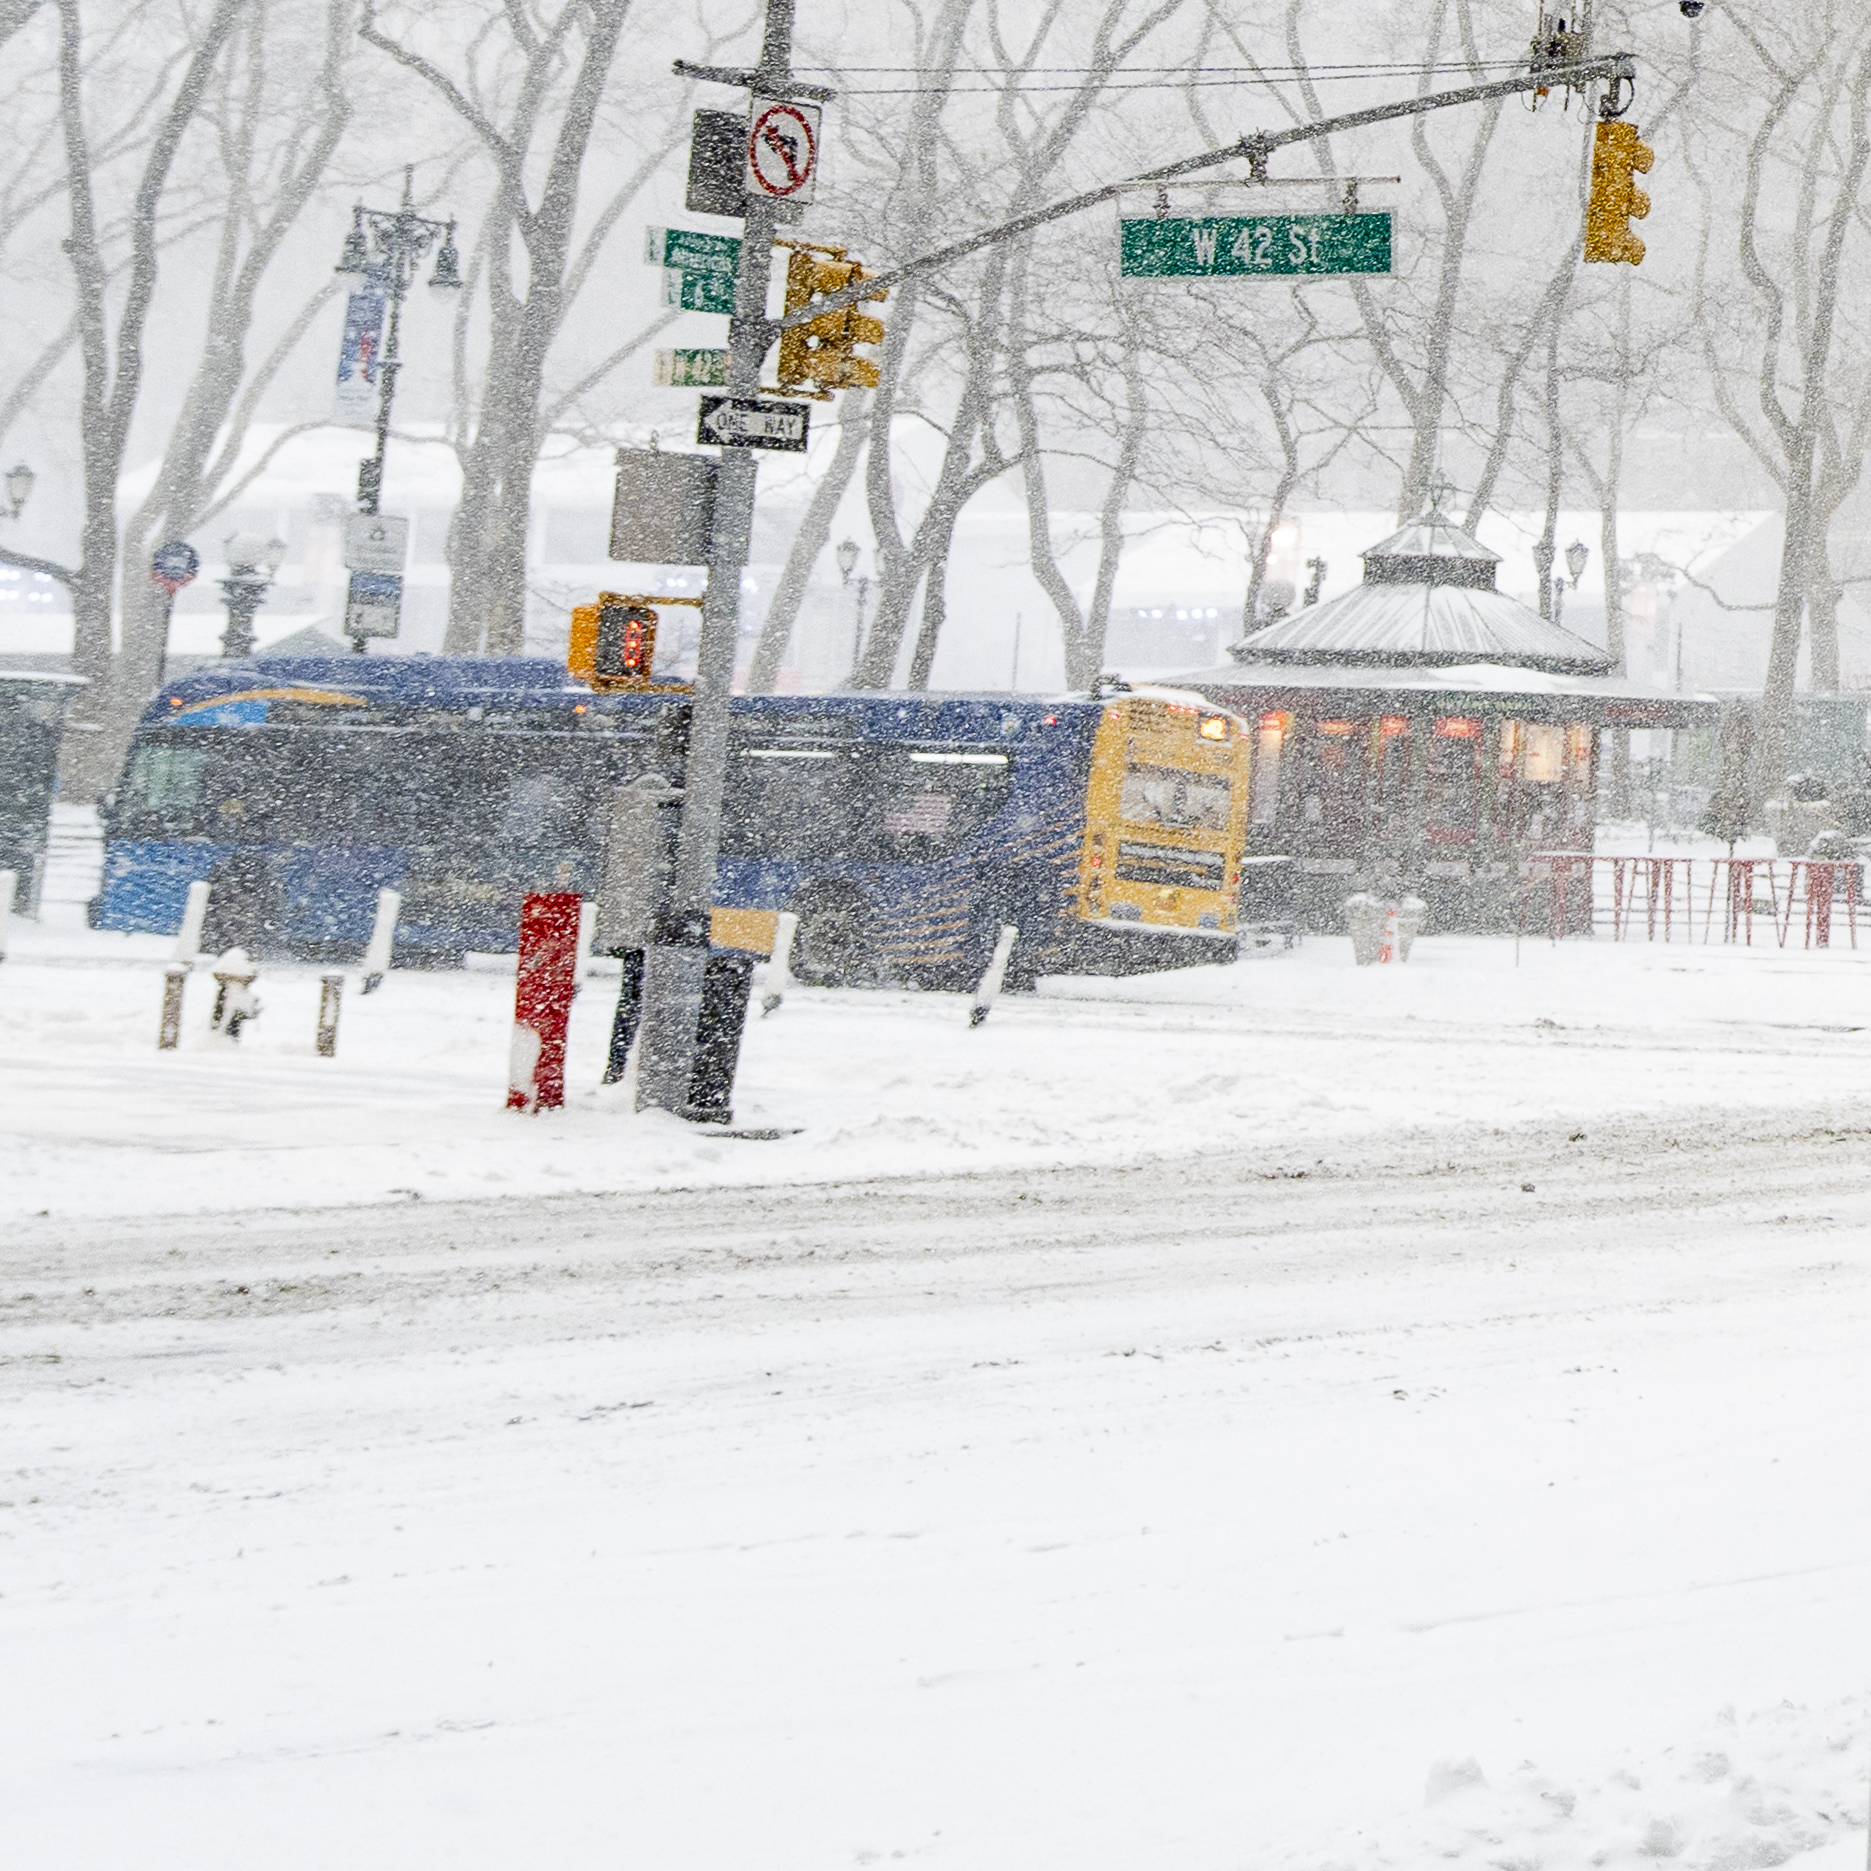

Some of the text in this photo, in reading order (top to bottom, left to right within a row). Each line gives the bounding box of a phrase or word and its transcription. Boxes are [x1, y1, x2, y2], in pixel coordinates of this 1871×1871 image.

[1192, 224, 1323, 266] W 42 St
[716, 412, 796, 436] ONE WAY
